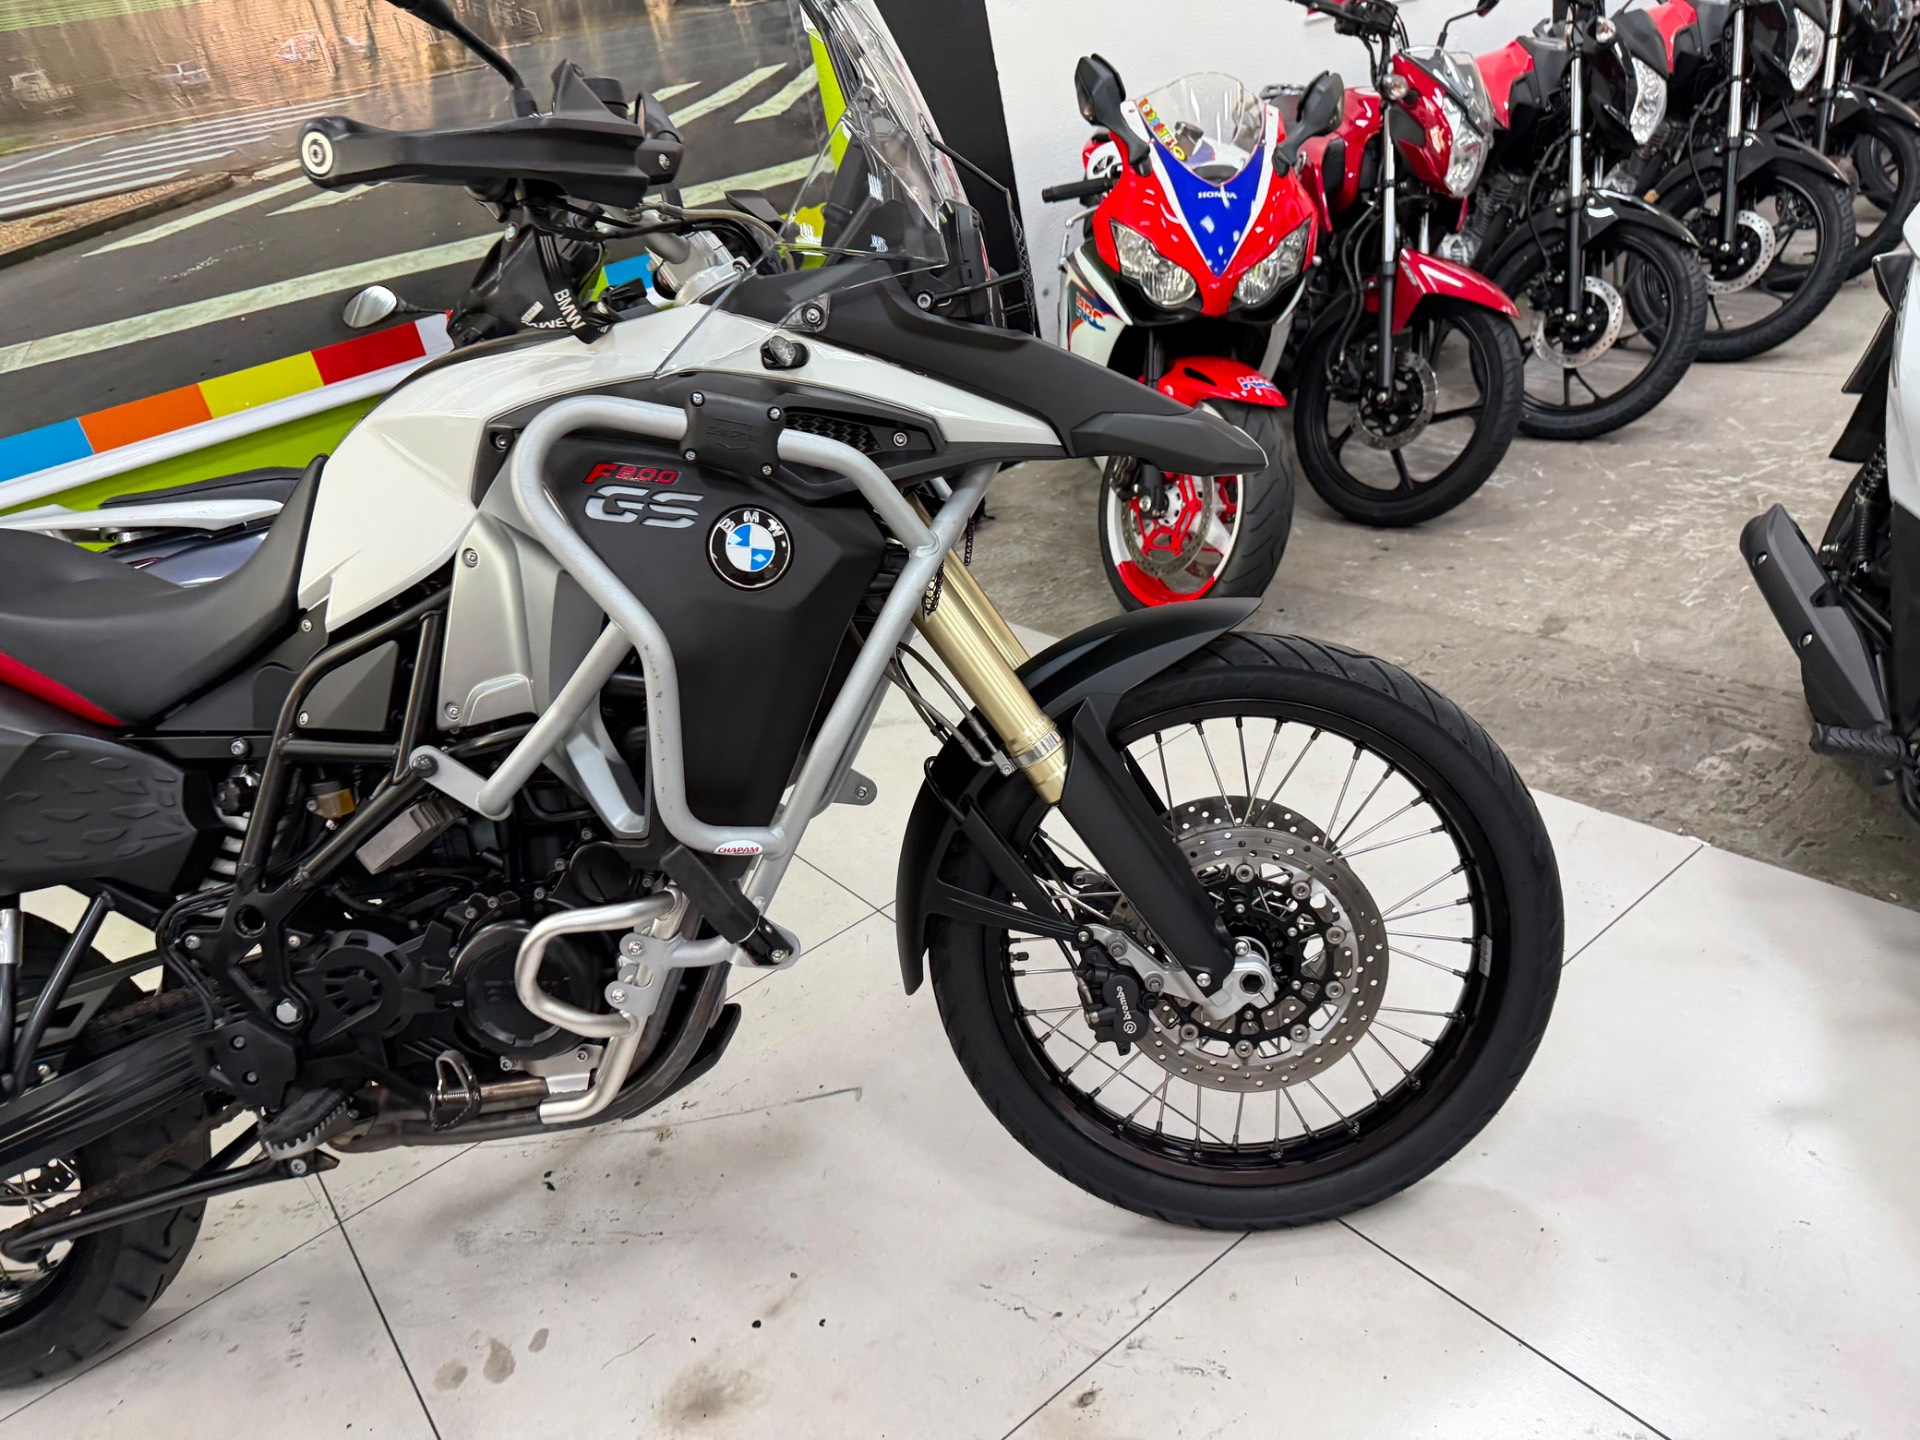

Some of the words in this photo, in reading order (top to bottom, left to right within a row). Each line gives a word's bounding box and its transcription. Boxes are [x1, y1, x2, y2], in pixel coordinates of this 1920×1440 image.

[1197, 191, 1238, 200] HONDA
[554, 288, 587, 330] BMW
[583, 463, 680, 484] F800
[585, 485, 705, 528] GS
[720, 510, 784, 537] BMW
[1116, 985, 1132, 1021] brembo
